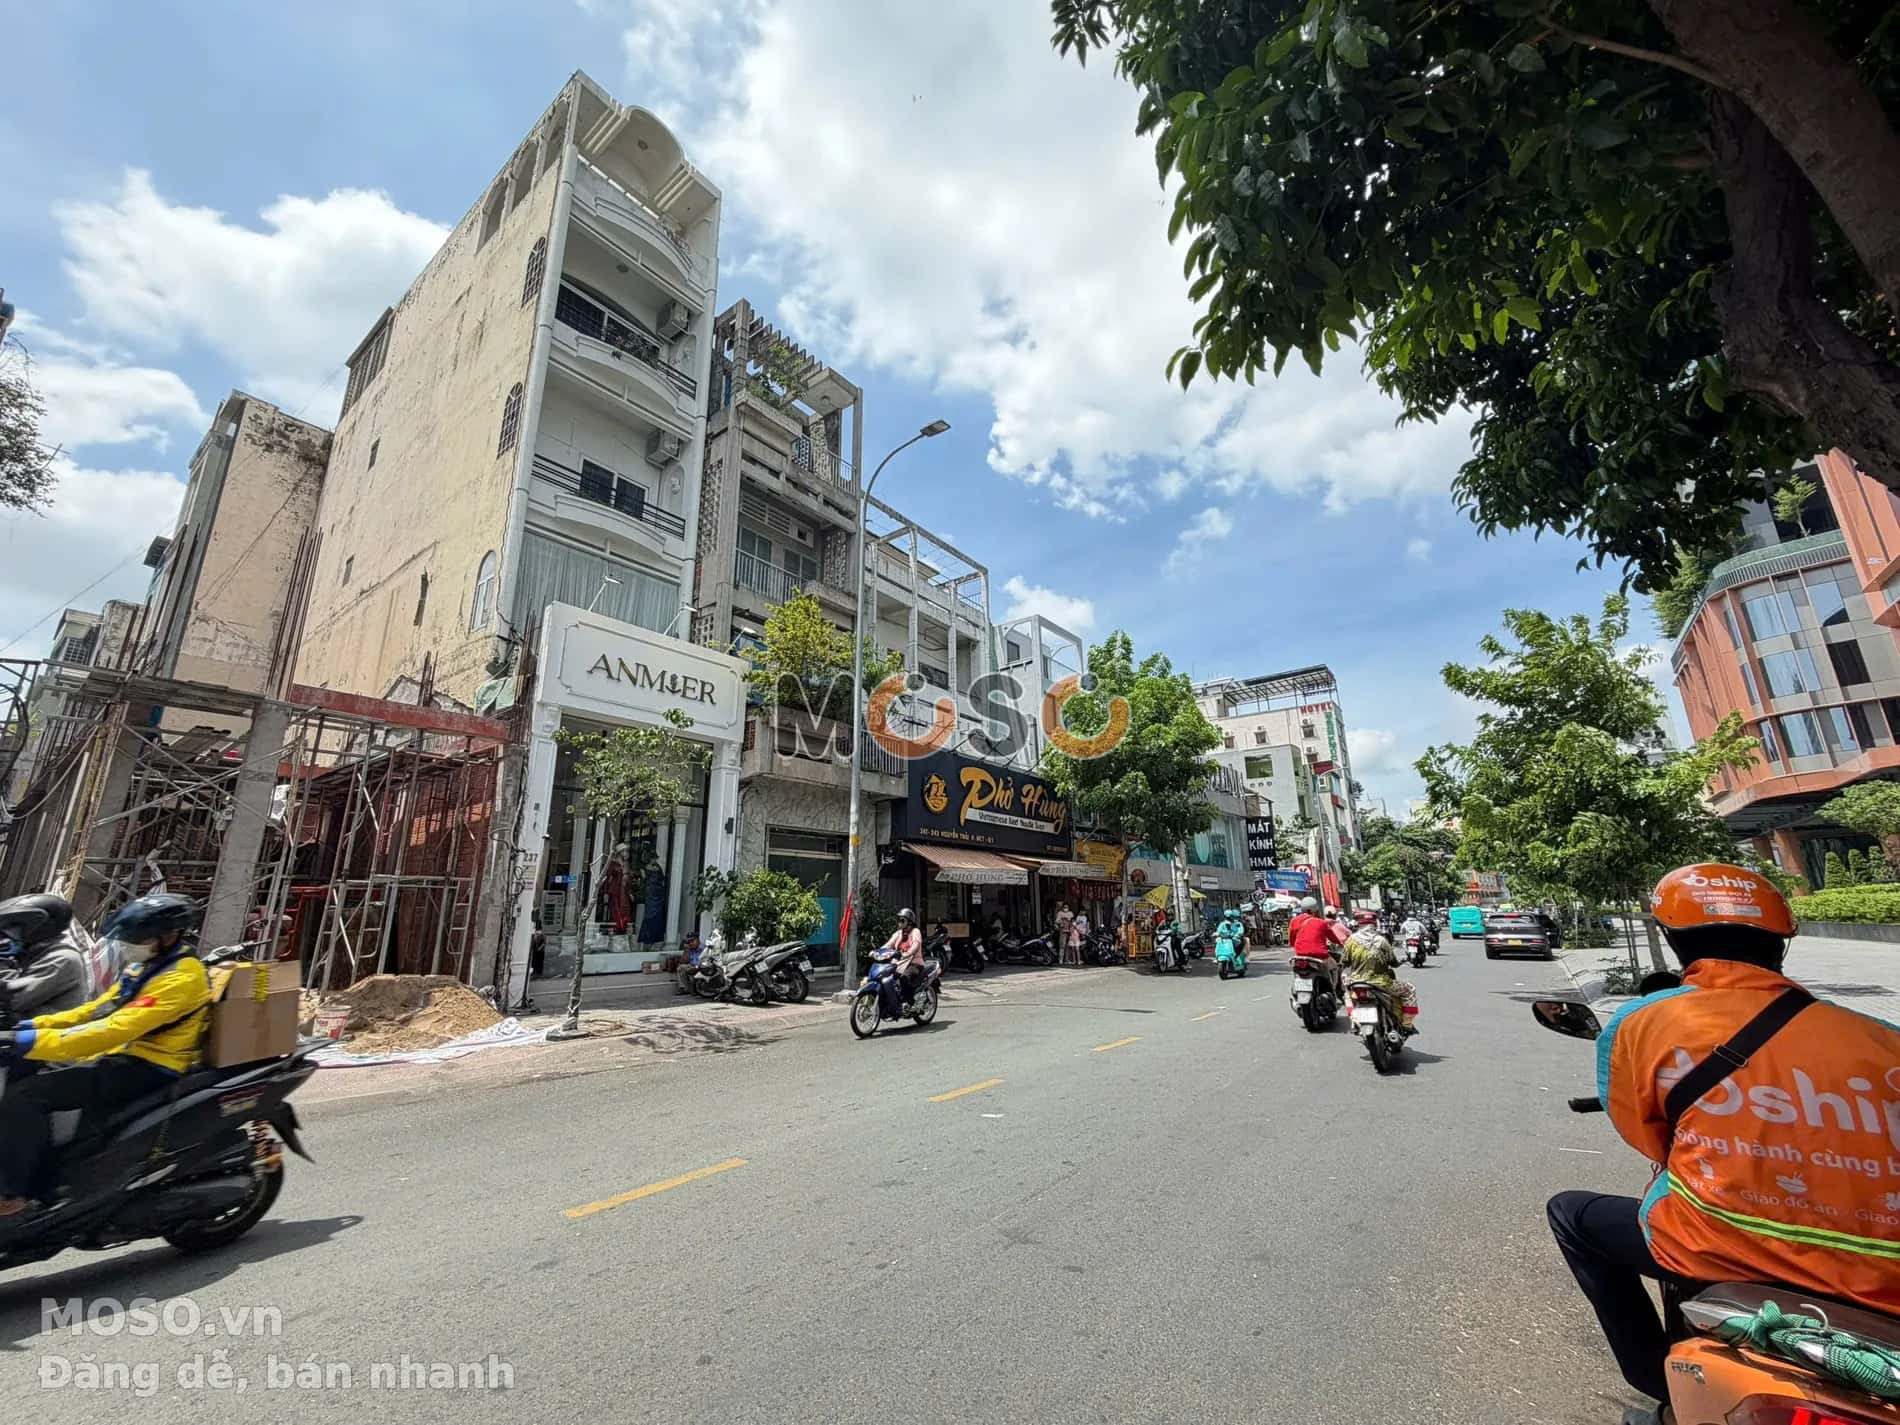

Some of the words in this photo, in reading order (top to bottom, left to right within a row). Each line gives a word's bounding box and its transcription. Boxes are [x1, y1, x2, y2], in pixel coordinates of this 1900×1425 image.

[960, 767, 1014, 826] Phở
[1021, 783, 1067, 835] Hùng
[1248, 836, 1273, 850] KÍNH
[1249, 856, 1275, 867] HMK
[1735, 1136, 1803, 1163] hành
[1810, 1147, 1881, 1178] cùng
